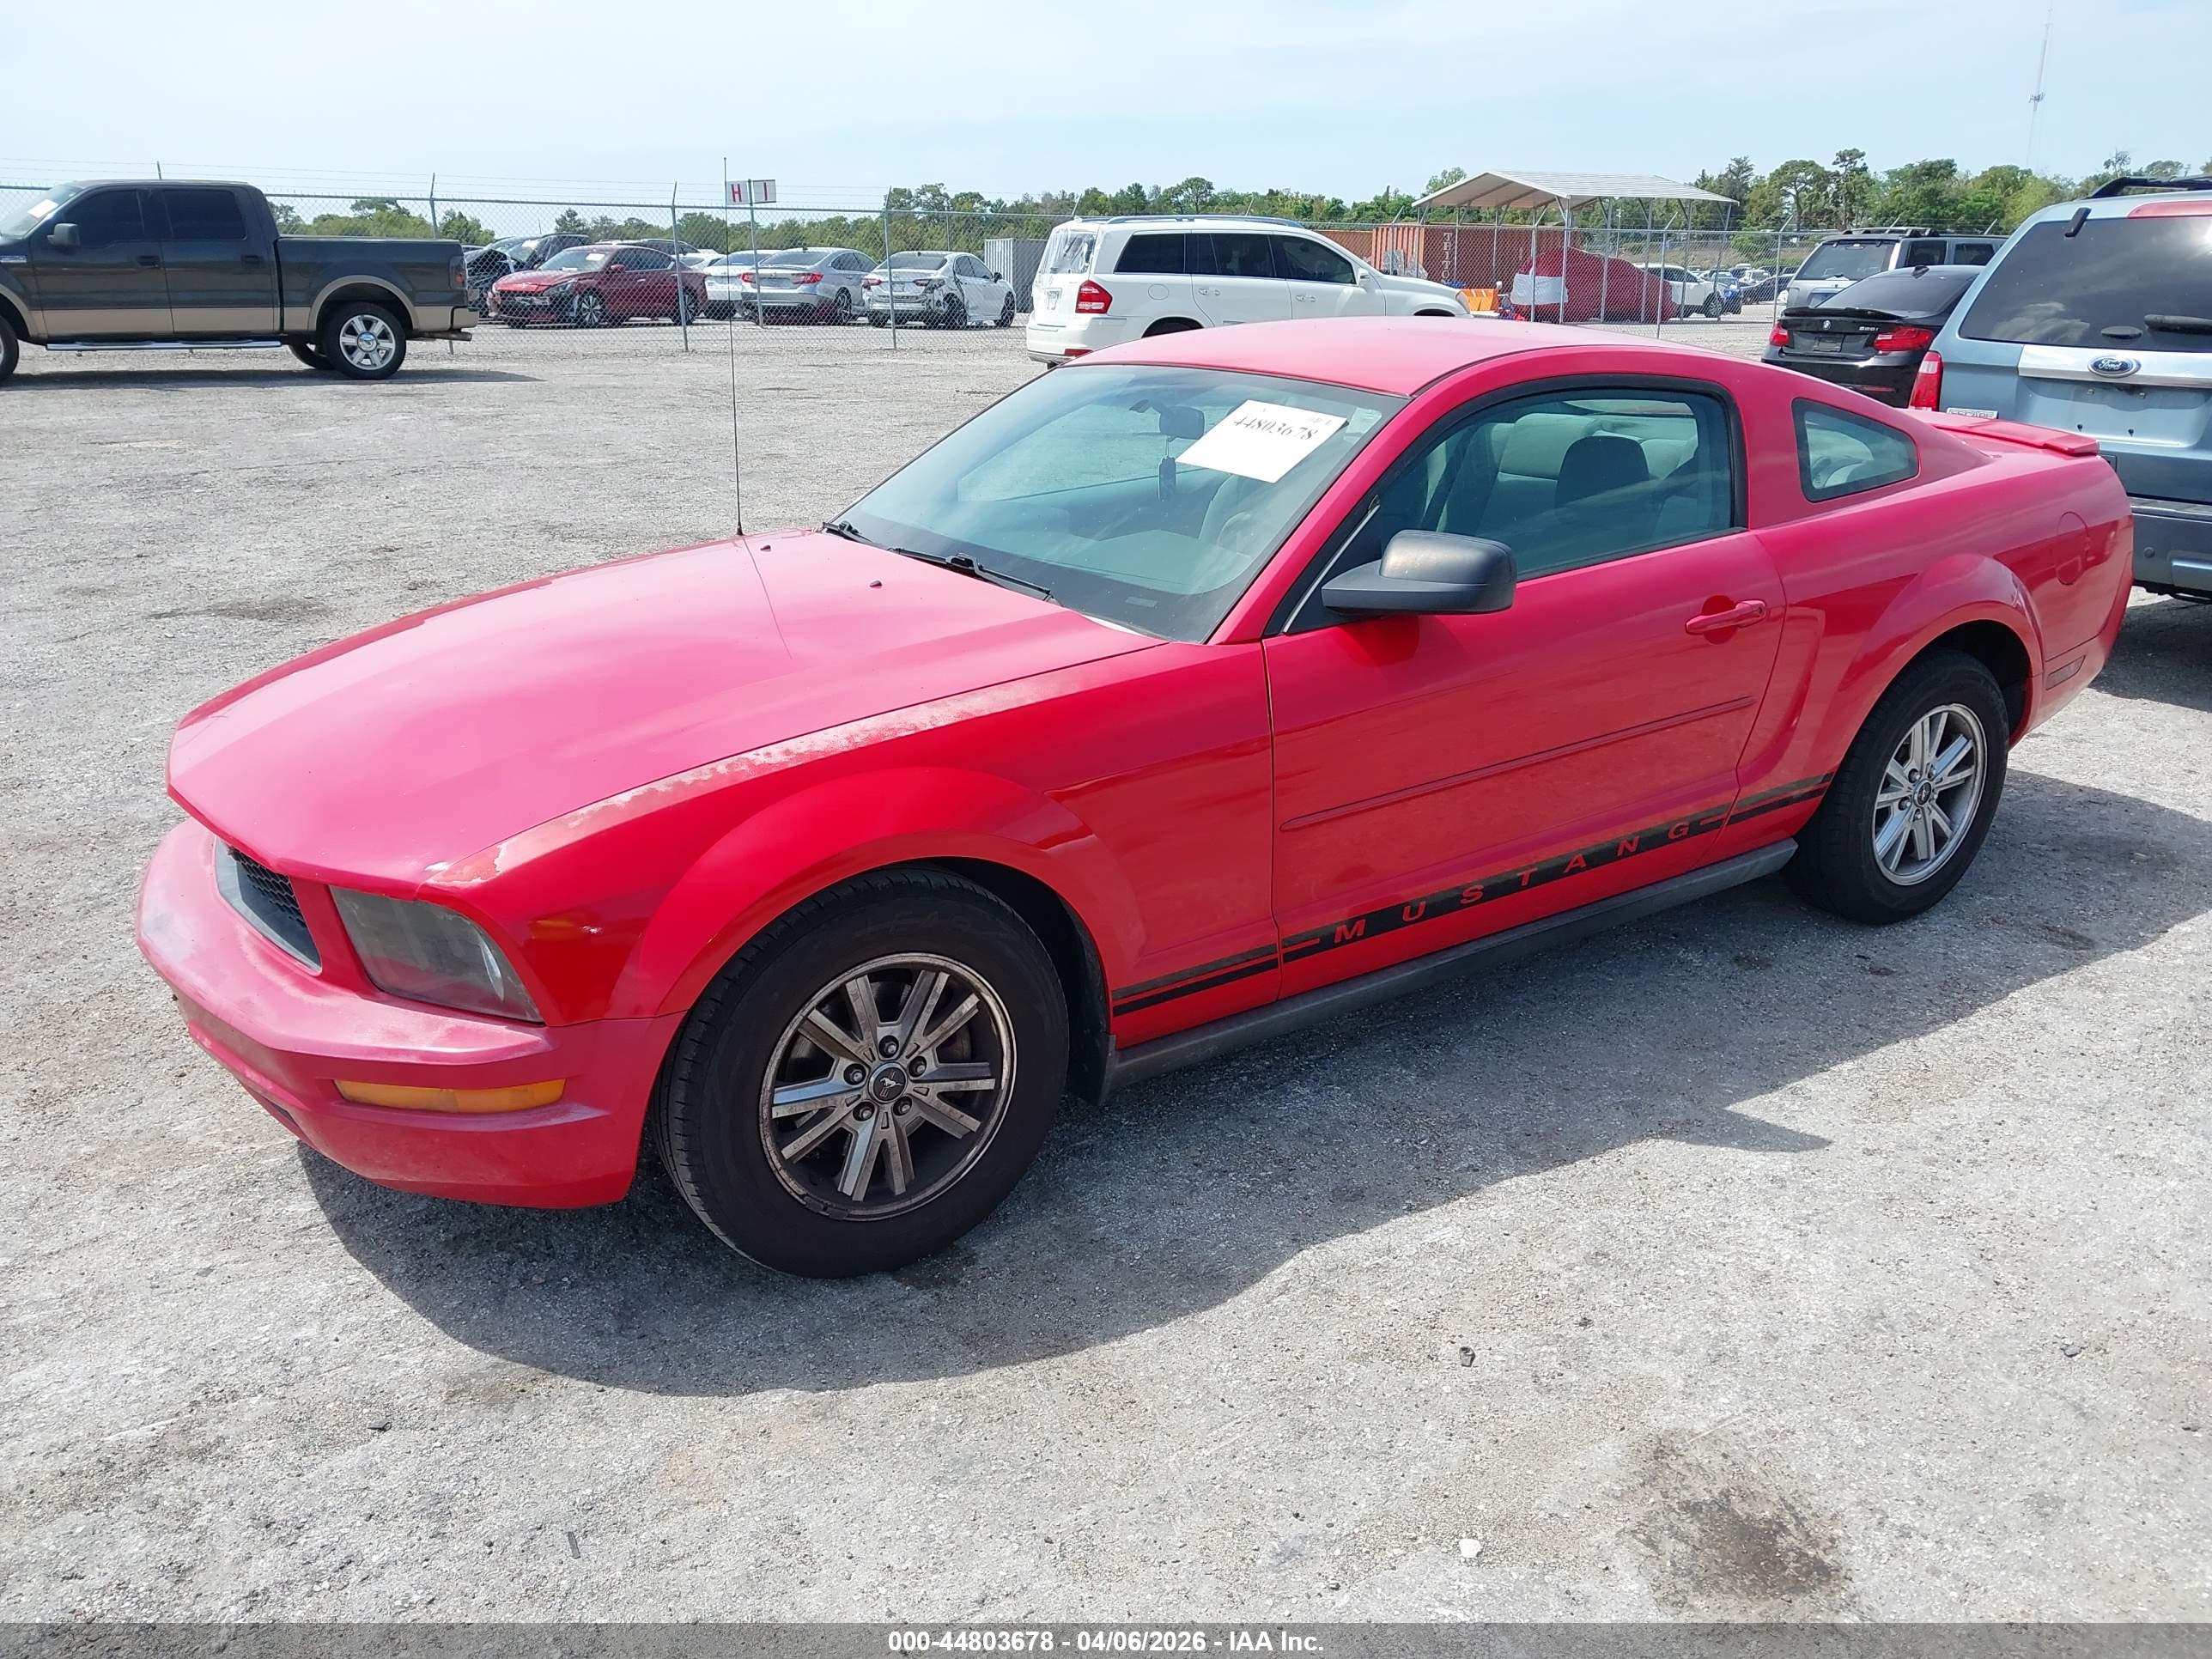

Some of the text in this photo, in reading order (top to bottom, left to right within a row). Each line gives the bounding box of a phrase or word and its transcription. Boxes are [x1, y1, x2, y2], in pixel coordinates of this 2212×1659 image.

[731, 183, 743, 203] H
[1234, 416, 1318, 440] 44803678
[1334, 822, 1690, 944] MUSTANG
